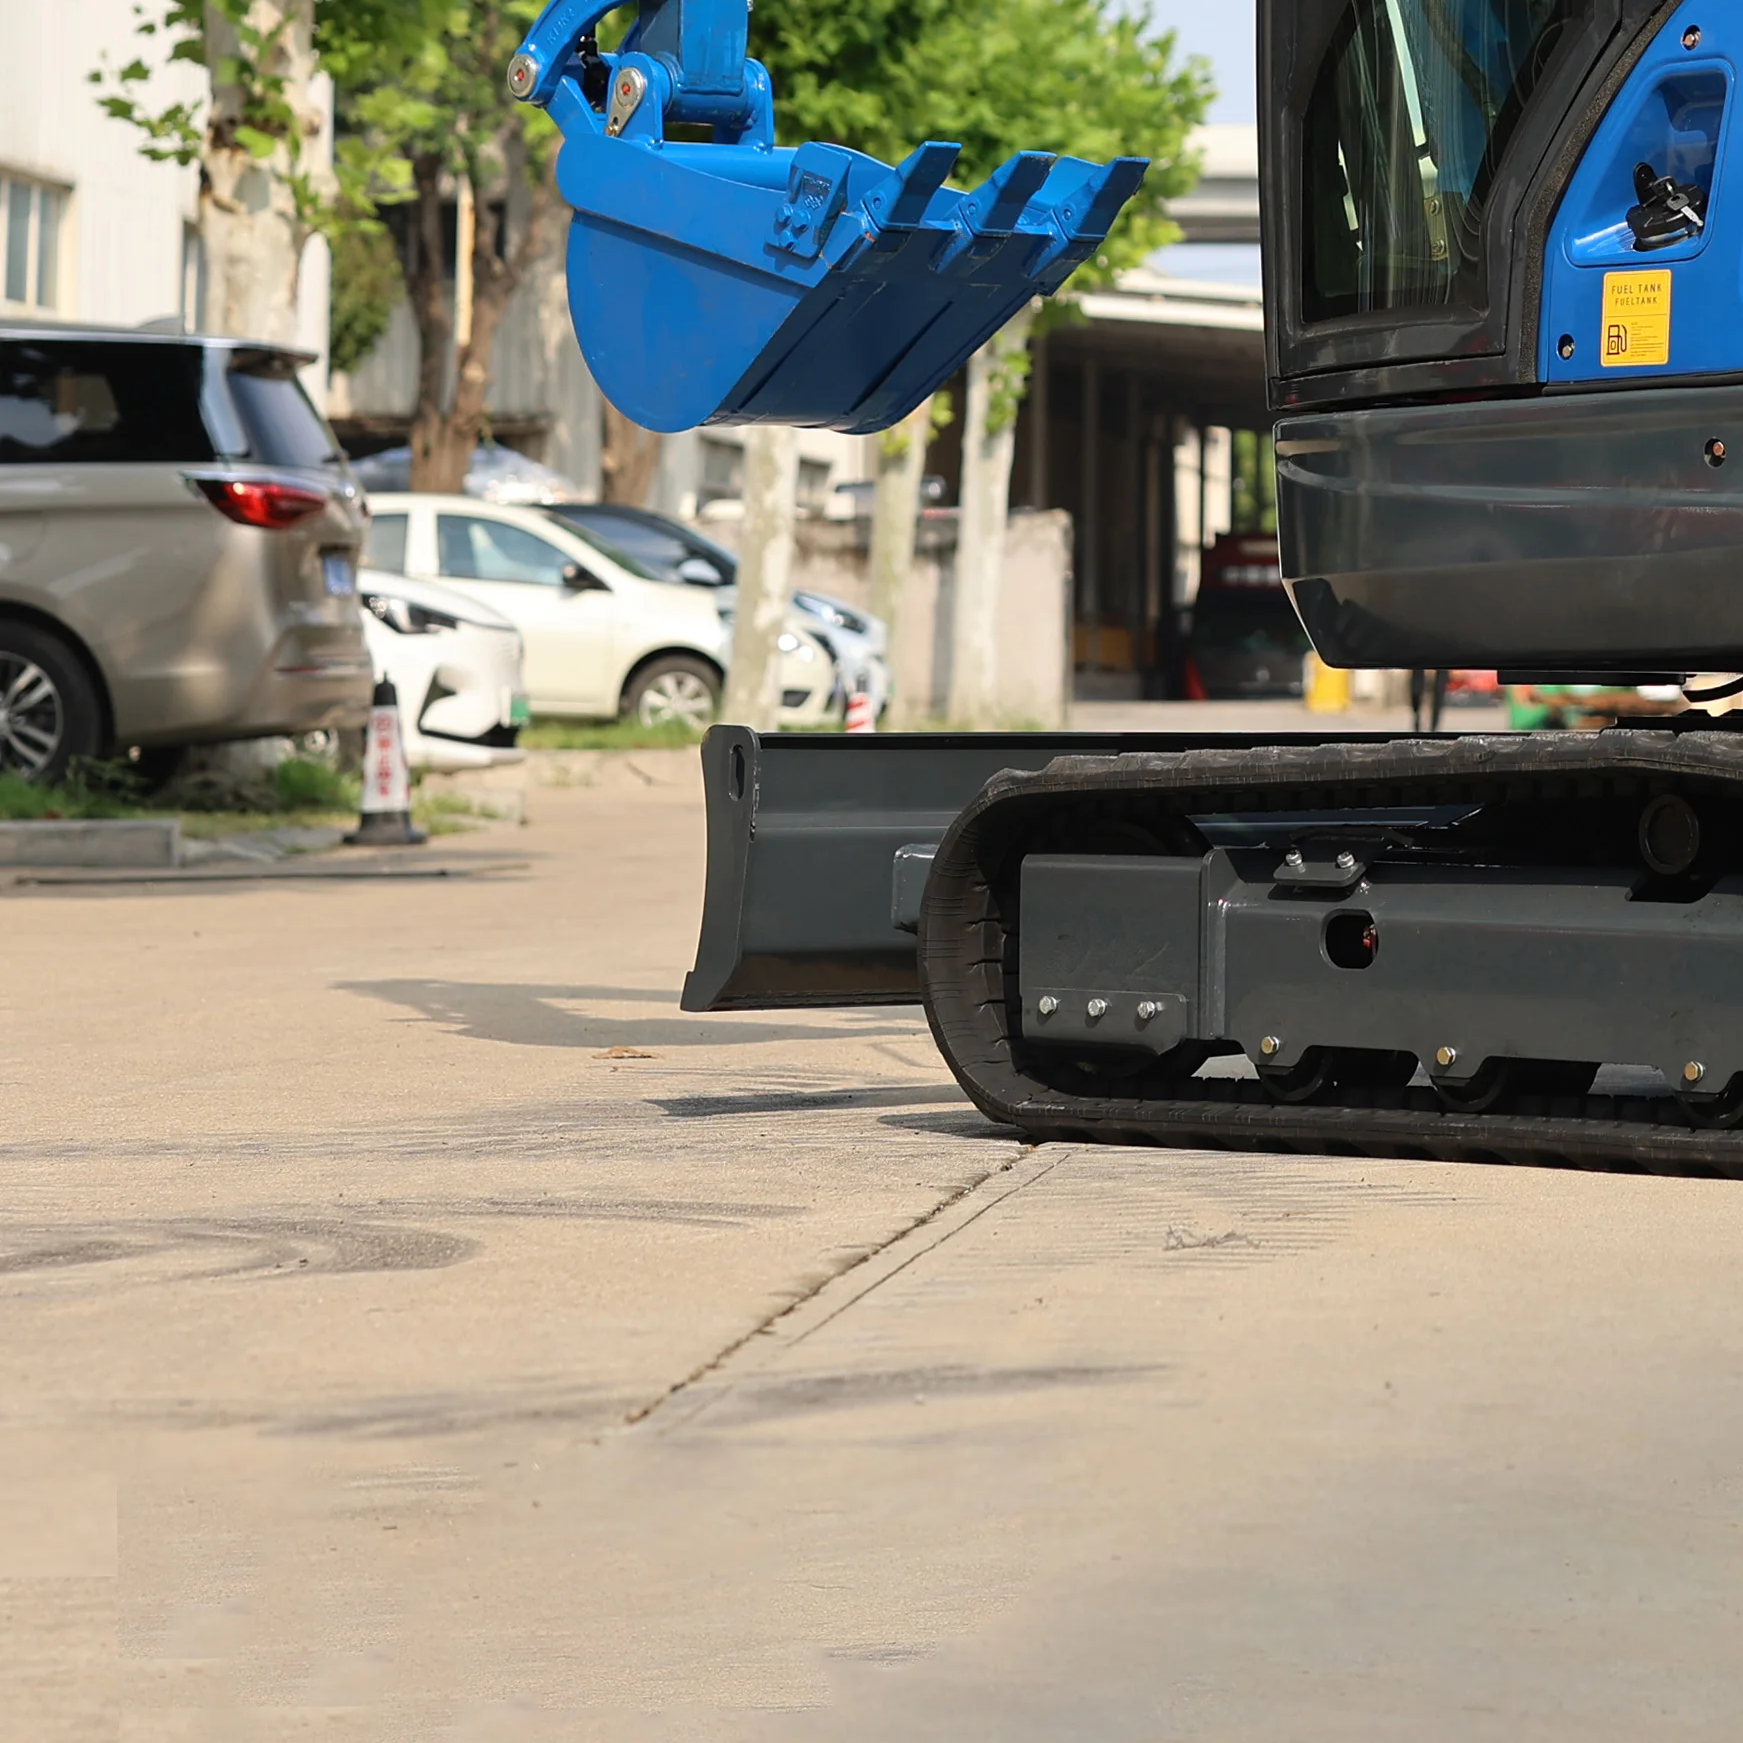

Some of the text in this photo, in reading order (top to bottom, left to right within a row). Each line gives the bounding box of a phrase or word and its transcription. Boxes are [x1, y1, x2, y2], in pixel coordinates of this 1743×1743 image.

[1611, 283, 1661, 295] FUEL TANK
[1615, 296, 1658, 306] FUELTANK
